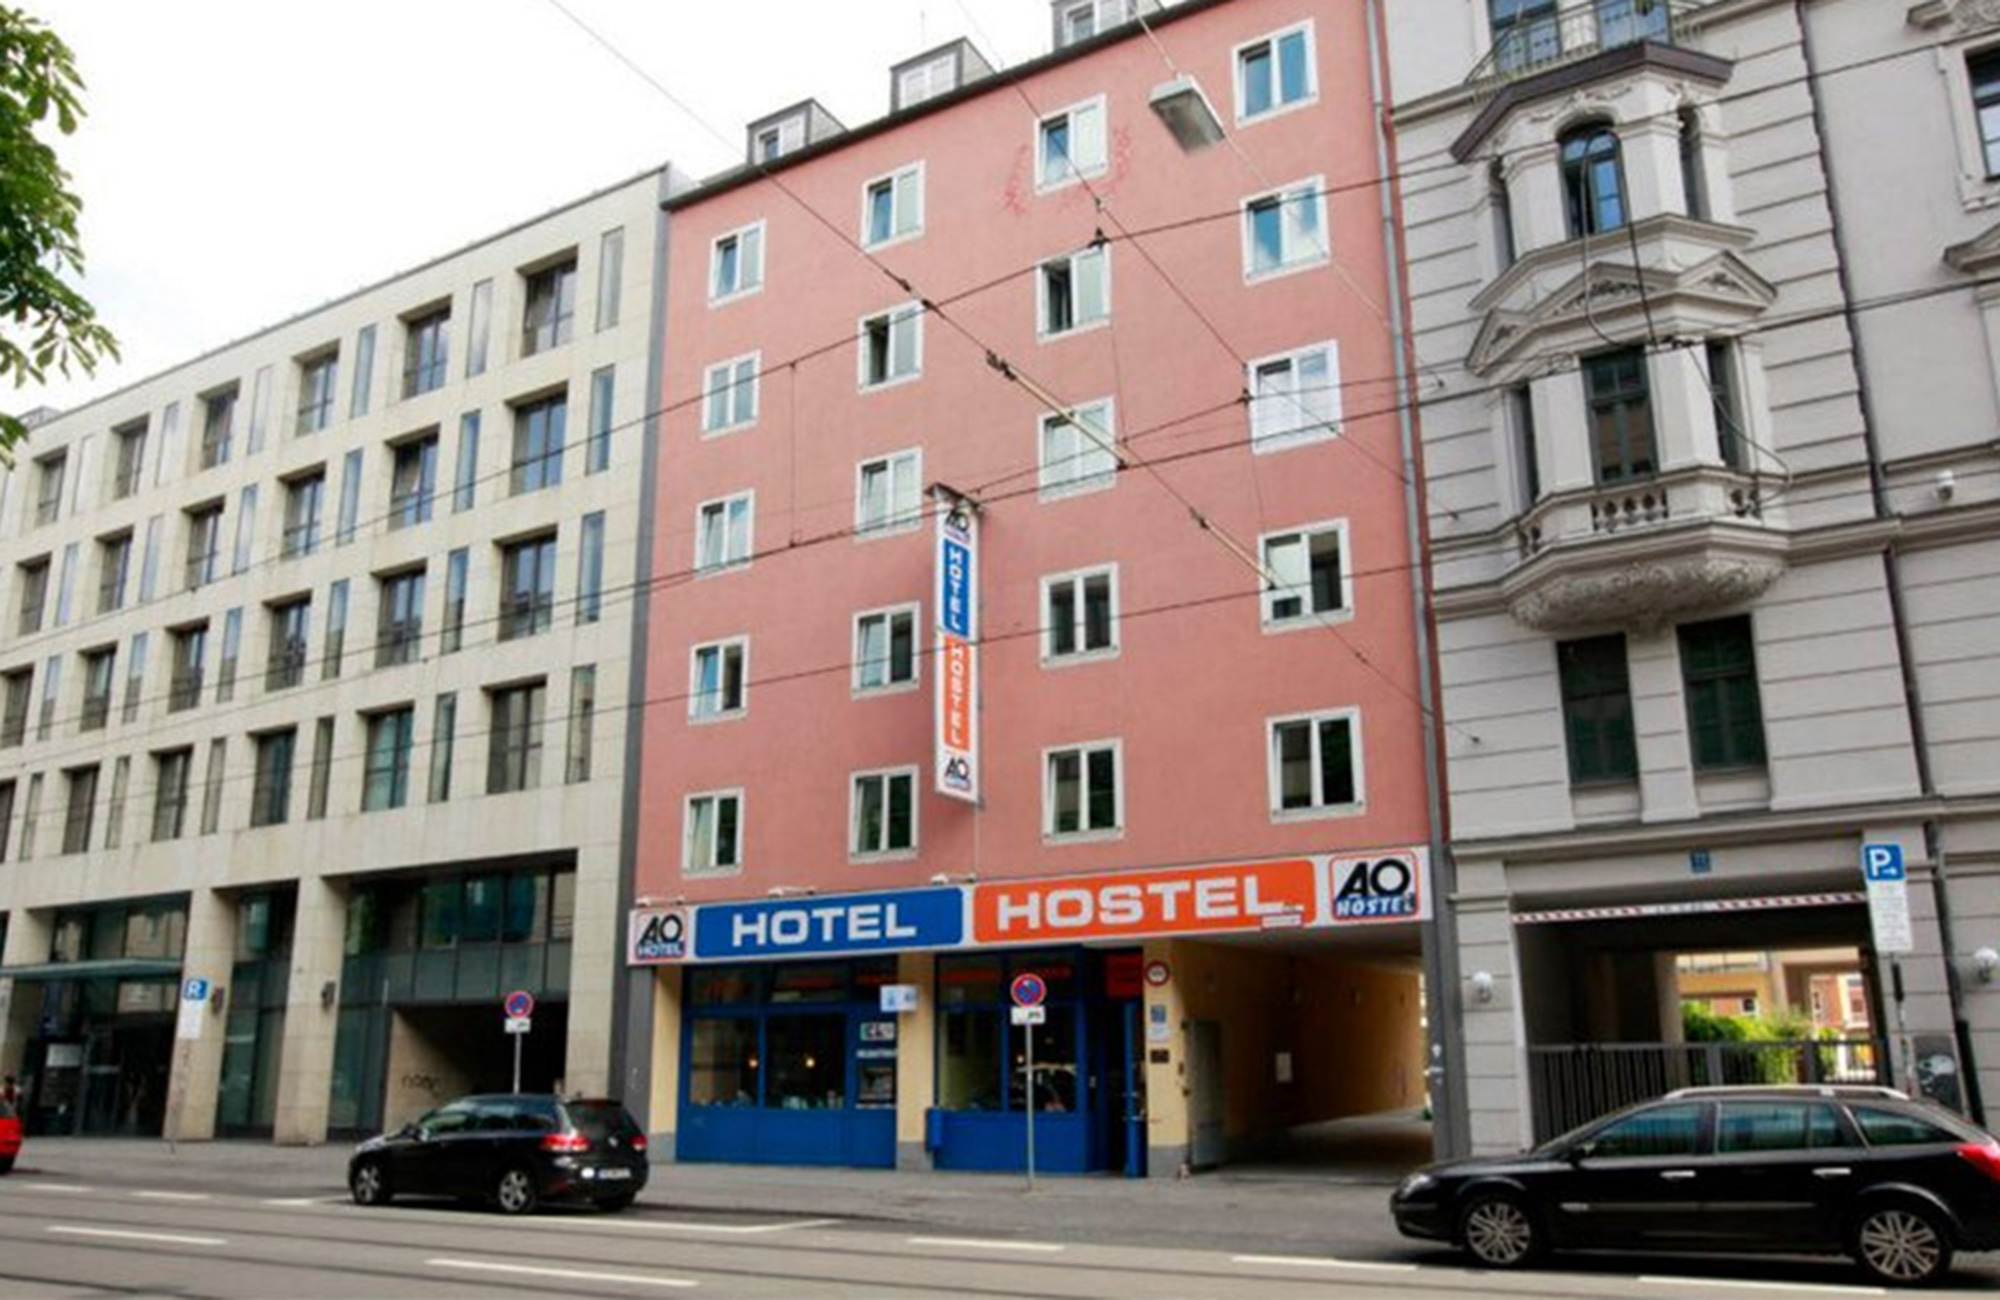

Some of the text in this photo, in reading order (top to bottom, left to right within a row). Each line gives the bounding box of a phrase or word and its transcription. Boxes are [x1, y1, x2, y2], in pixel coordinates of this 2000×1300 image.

[949, 547, 963, 631] HOTEL
[951, 645, 964, 744] HOSTEL
[1336, 858, 1411, 899] AO
[1870, 848, 1891, 876] P
[998, 876, 1285, 931] HOSTEL
[1337, 894, 1413, 916] HOSTEL
[638, 914, 683, 945] AO
[732, 903, 917, 947] HOTEL
[637, 943, 682, 957] HOTEL
